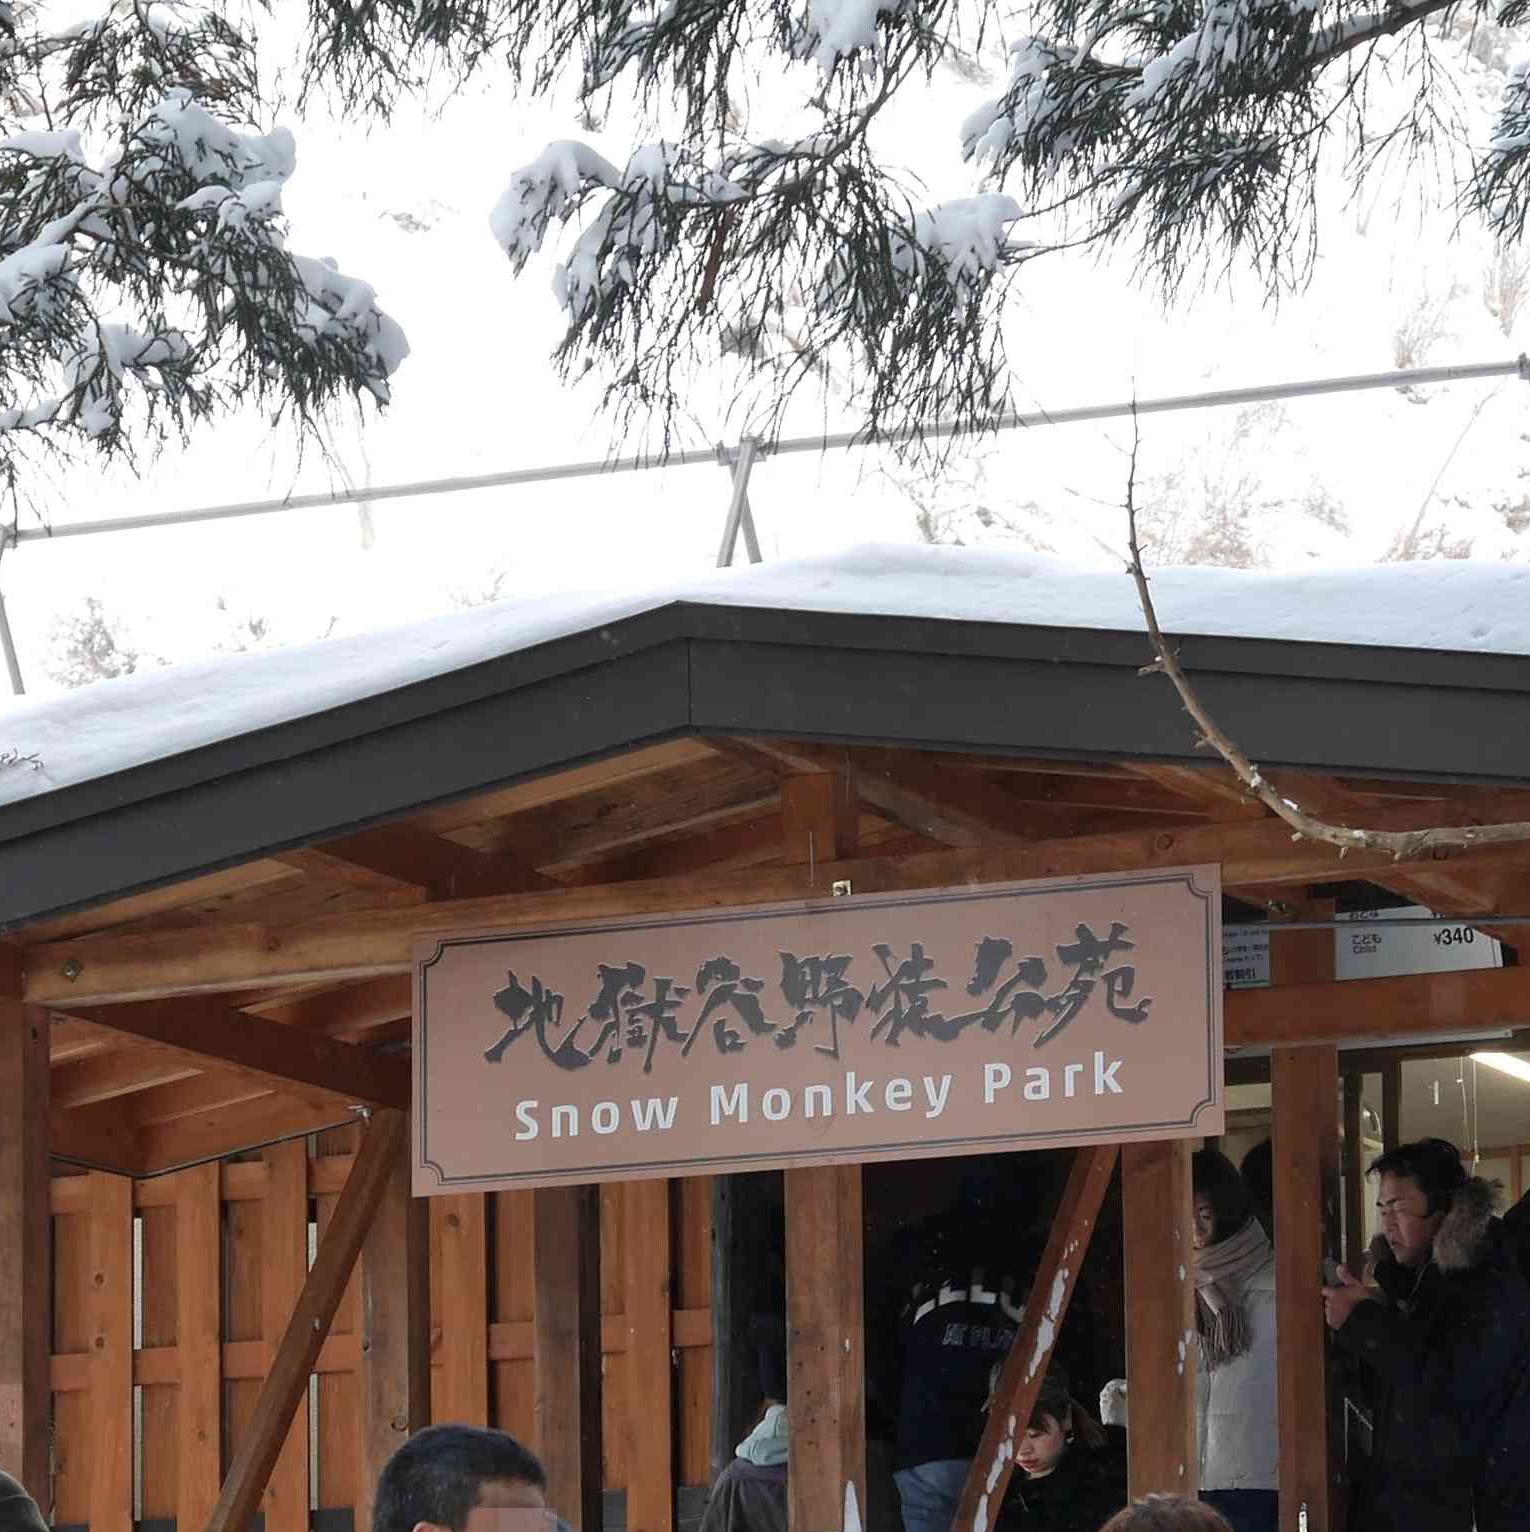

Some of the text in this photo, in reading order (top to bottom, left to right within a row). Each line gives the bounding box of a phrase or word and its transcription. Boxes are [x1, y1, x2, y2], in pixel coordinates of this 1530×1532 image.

[1433, 927, 1475, 946] ¥340
[513, 1050, 1125, 1142] Snow Monkey Park
